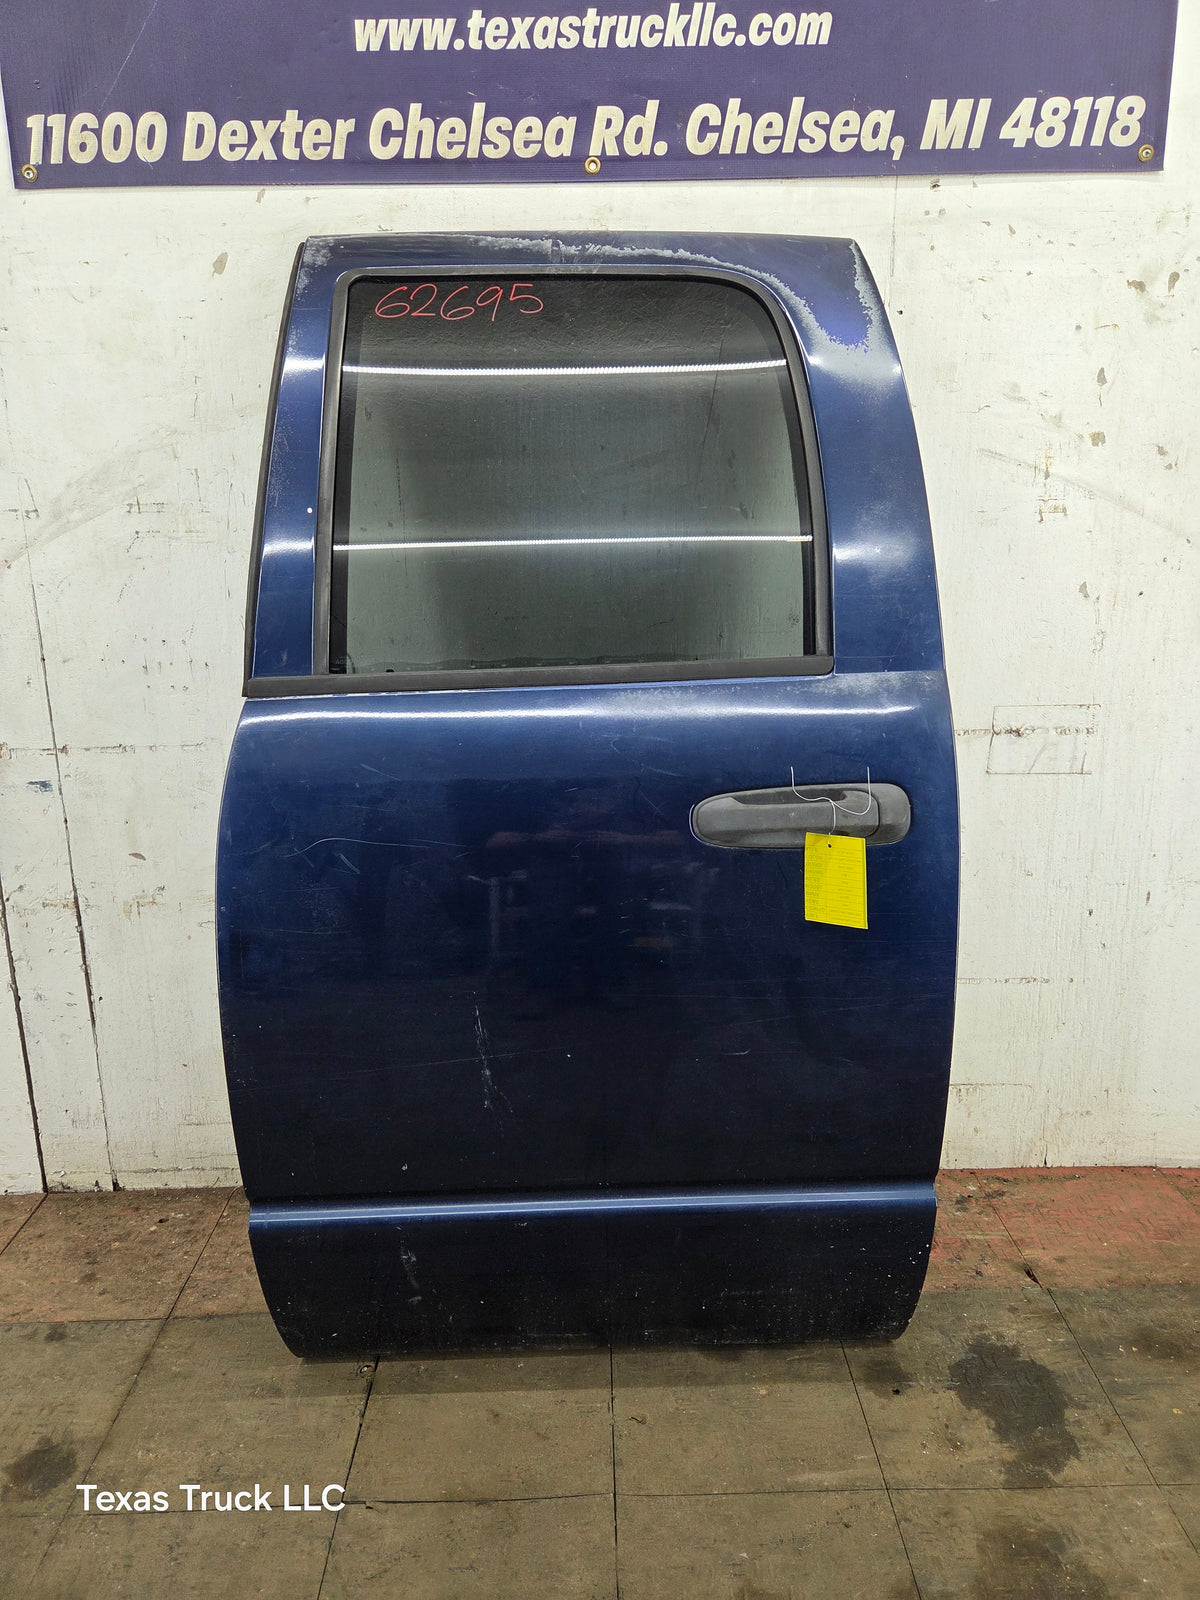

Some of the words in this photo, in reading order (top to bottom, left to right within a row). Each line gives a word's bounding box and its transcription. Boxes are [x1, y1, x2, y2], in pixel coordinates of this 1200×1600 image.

[353, 2, 833, 52] www.texastruckllc.com
[26, 111, 168, 167] 11600
[182, 109, 356, 162] Dexter
[368, 102, 578, 160] Chelsea
[588, 99, 668, 157] Rd.
[685, 97, 905, 161] Chelsea,
[919, 97, 993, 151] MI
[998, 95, 1147, 150] 48118
[375, 283, 544, 322] 62695
